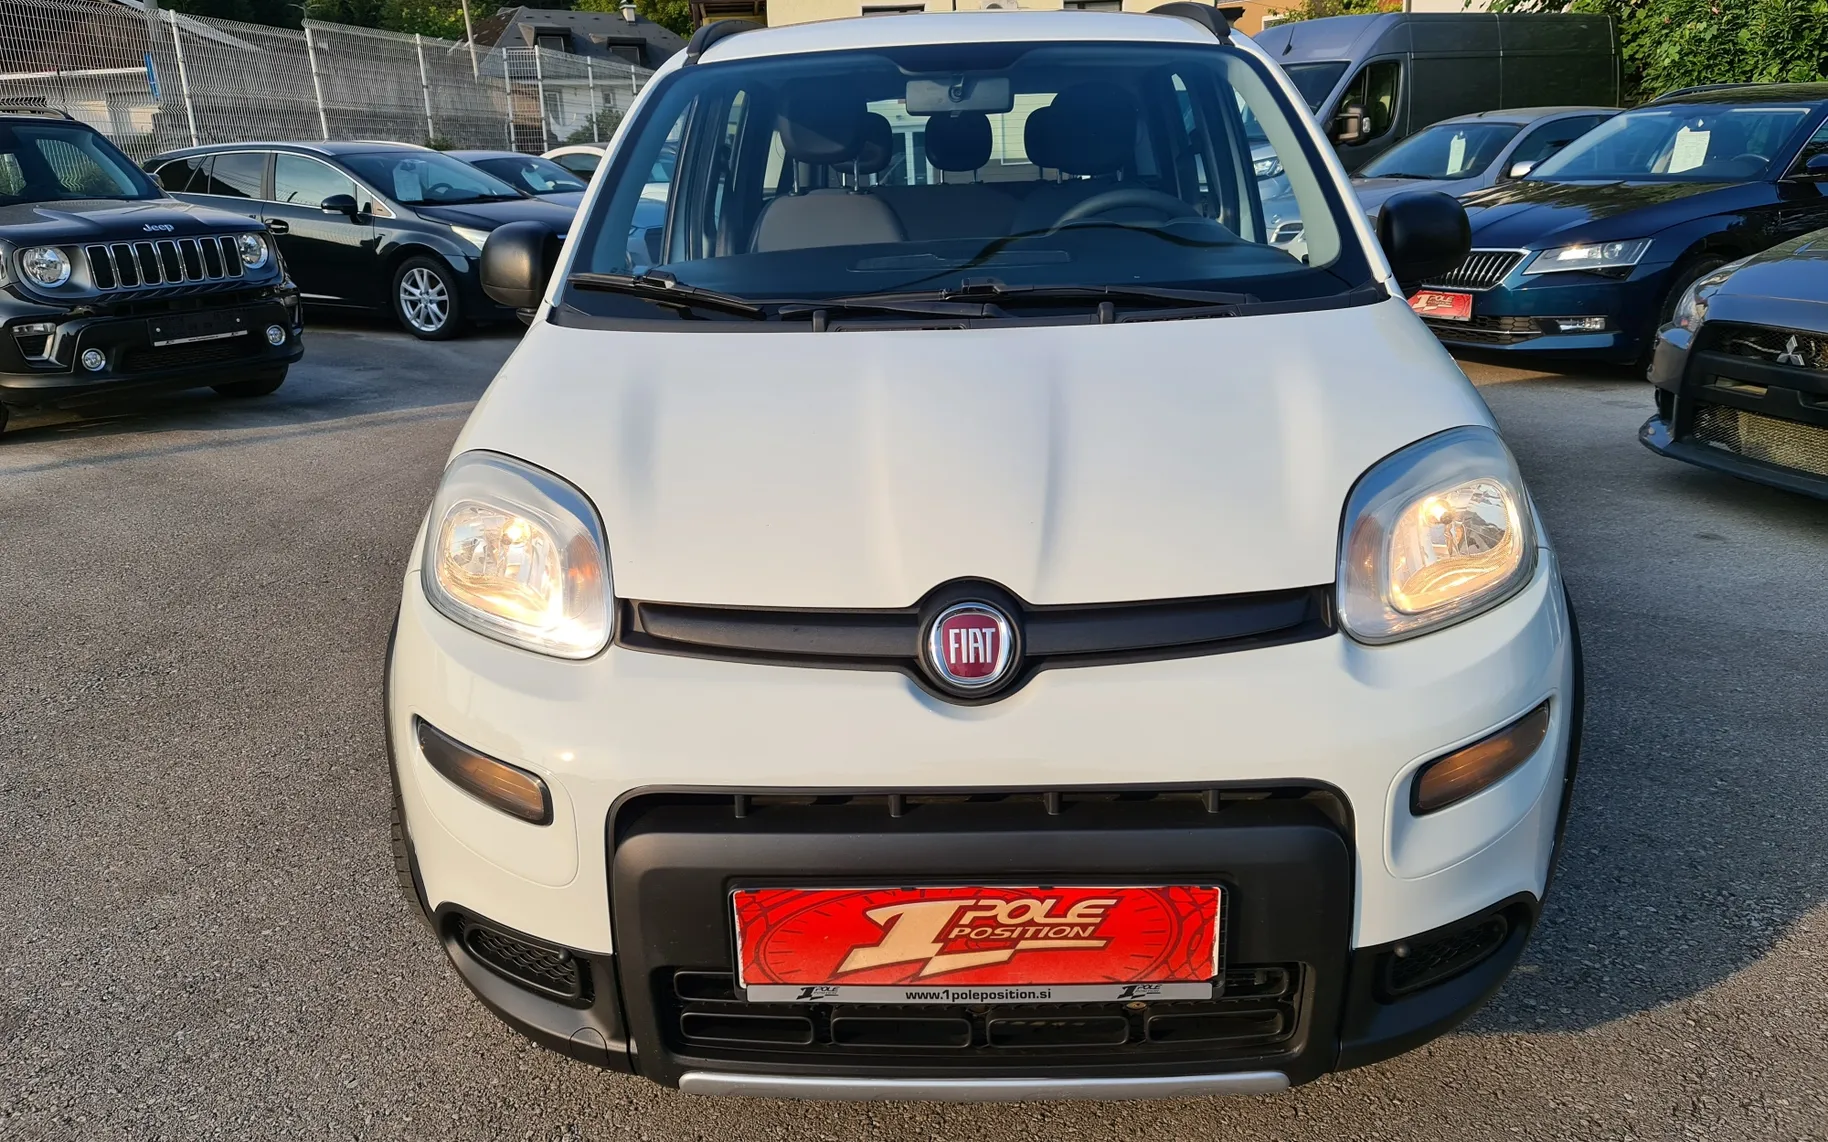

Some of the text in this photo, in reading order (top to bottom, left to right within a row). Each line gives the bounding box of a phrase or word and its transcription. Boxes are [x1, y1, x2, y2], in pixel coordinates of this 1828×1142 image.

[142, 223, 175, 232] Jeep
[949, 628, 996, 664] FIAT
[836, 899, 1118, 975] 1 POLE
[949, 926, 1096, 939] POSITION
[905, 988, 1052, 1003] www.1poleposition.si
